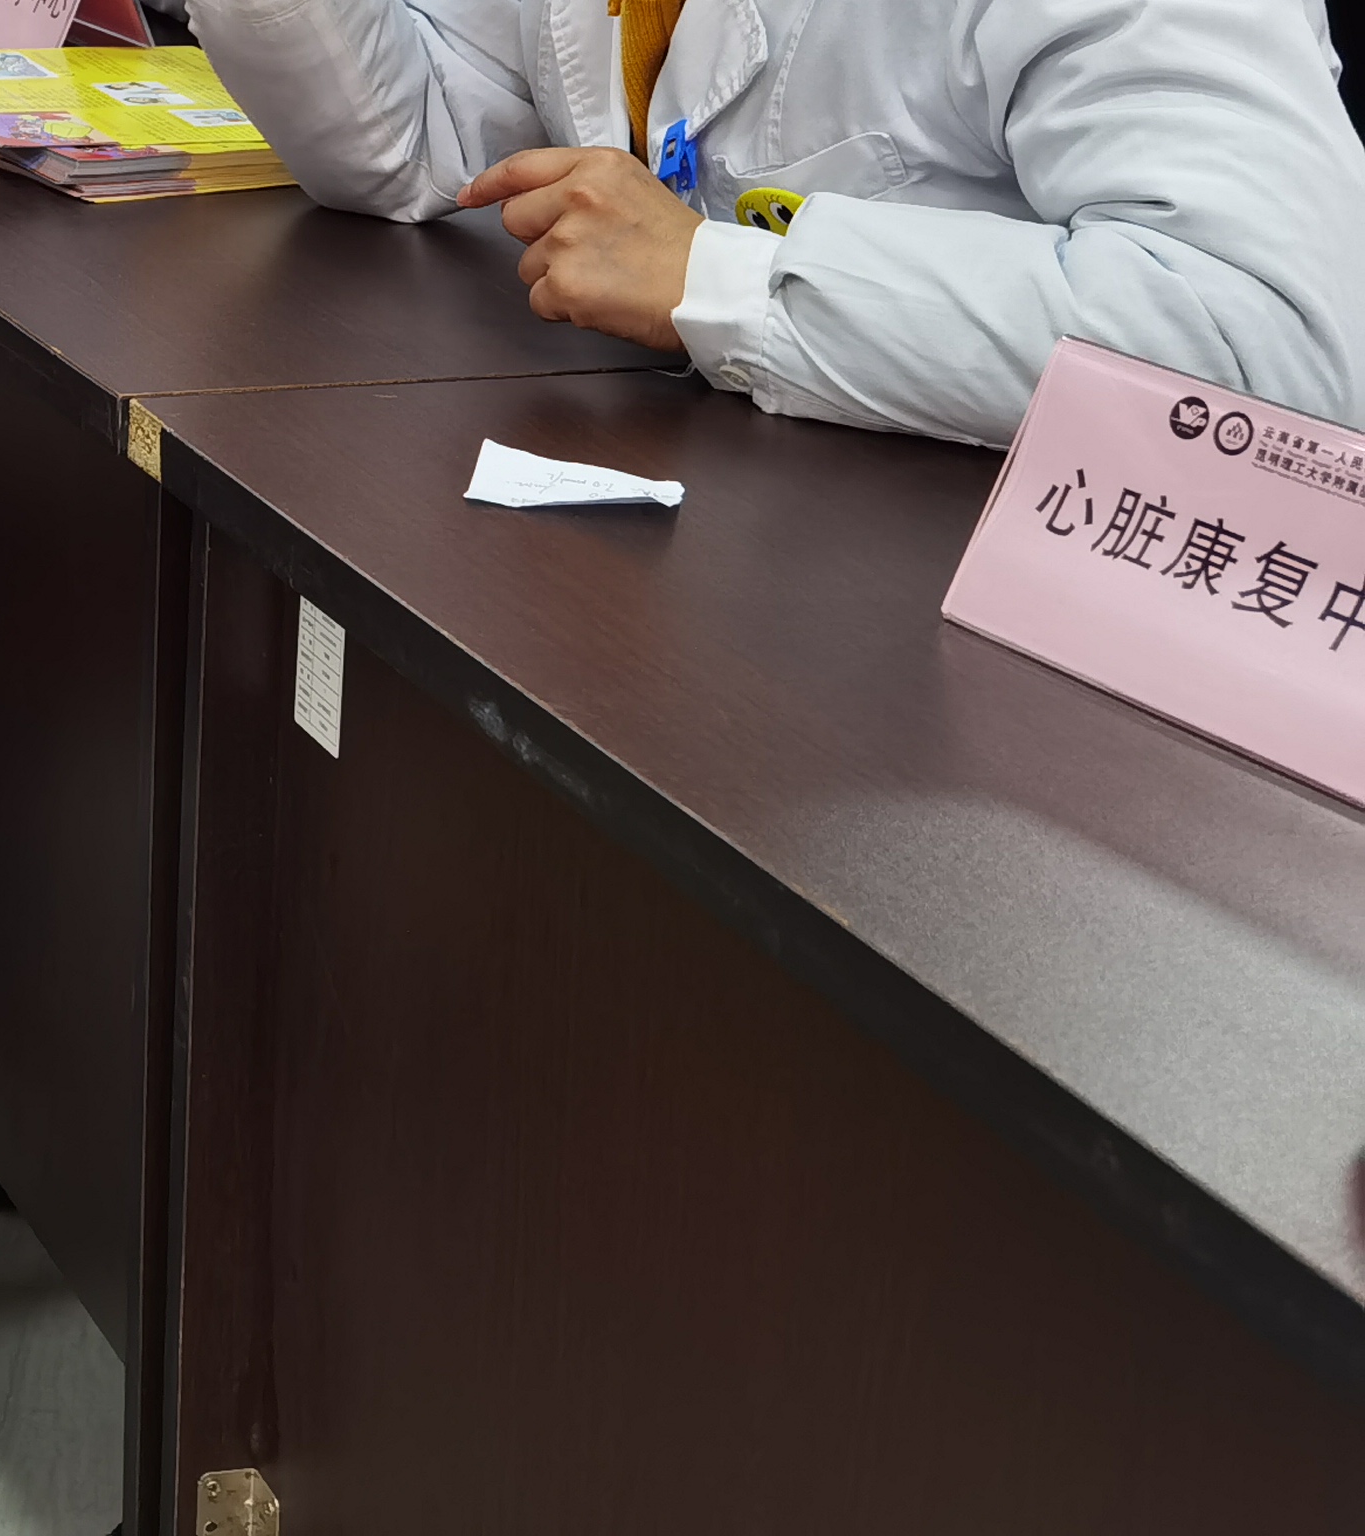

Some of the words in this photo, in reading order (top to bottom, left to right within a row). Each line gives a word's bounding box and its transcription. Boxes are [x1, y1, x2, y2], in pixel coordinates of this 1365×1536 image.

[1034, 468, 1365, 652] 心脏康复中
